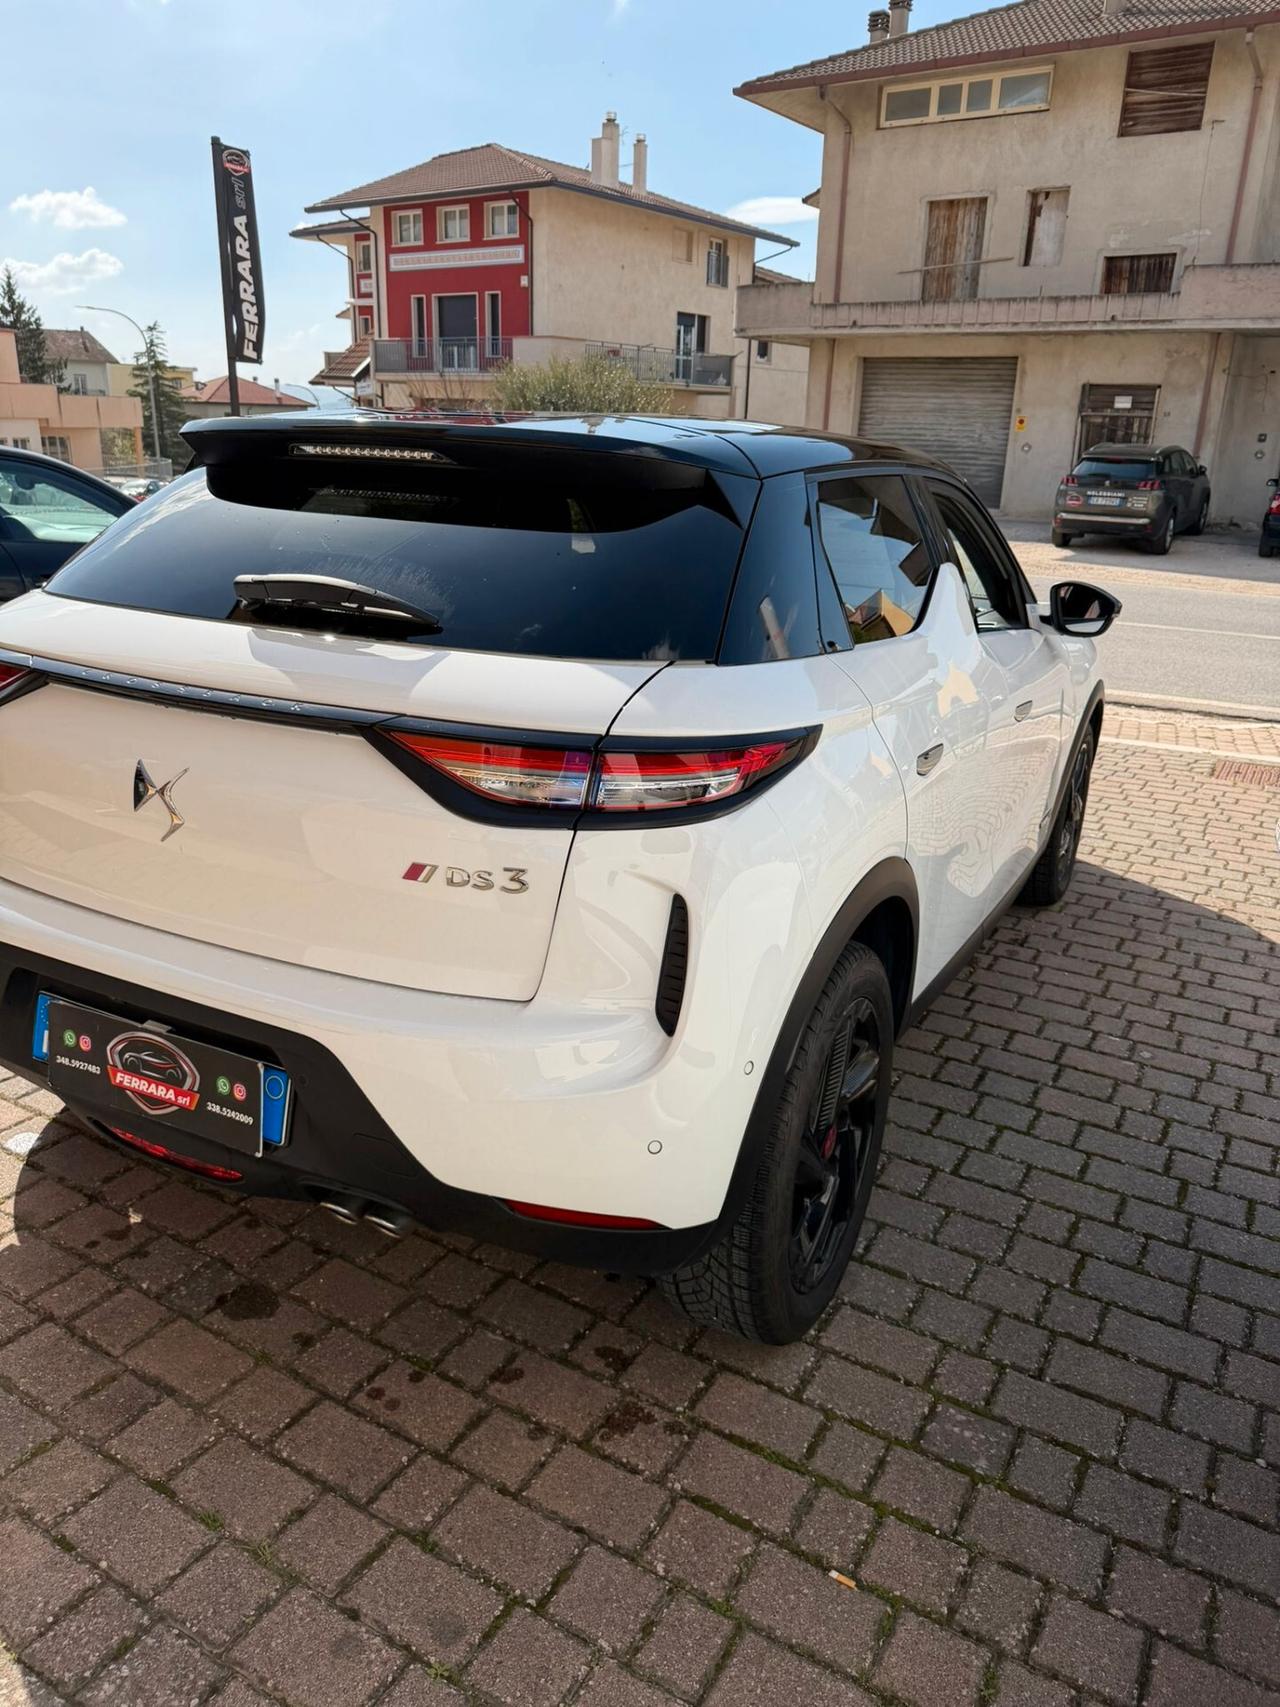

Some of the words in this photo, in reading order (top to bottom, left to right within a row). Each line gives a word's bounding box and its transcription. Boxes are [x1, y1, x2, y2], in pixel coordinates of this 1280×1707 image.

[231, 176, 247, 210] srl
[233, 214, 259, 360] FERRARA
[81, 668, 304, 711] CROSSBACK
[55, 1055, 101, 1074] 348.5927483
[115, 1072, 176, 1102] FERRARA
[177, 1094, 191, 1106] srl
[206, 1101, 254, 1126] 338.5242009
